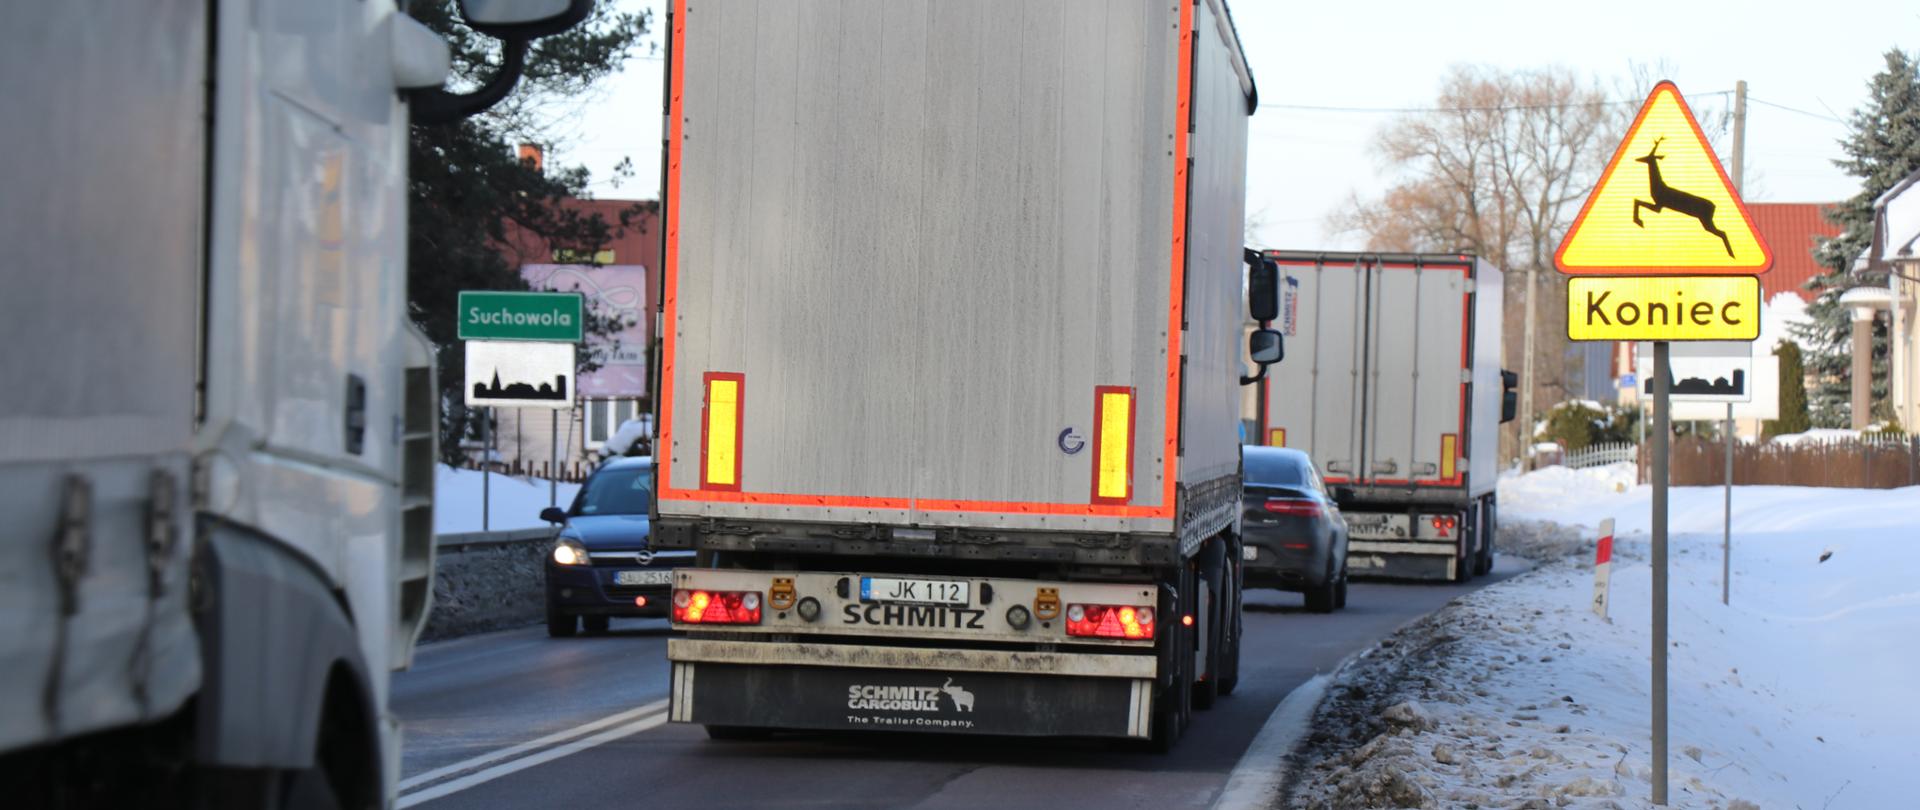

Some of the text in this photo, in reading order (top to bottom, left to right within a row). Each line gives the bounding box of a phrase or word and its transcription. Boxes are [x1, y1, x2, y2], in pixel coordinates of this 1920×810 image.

[468, 307, 572, 327] Suchowola
[1586, 290, 1742, 326] Koniec
[644, 571, 672, 584] 2516
[889, 581, 916, 599] JK
[926, 583, 960, 601] 112
[843, 603, 985, 629] SCHMITZ
[848, 685, 940, 701] SCHMITZ
[847, 699, 940, 711] CARGOBULL
[847, 715, 869, 724] The
